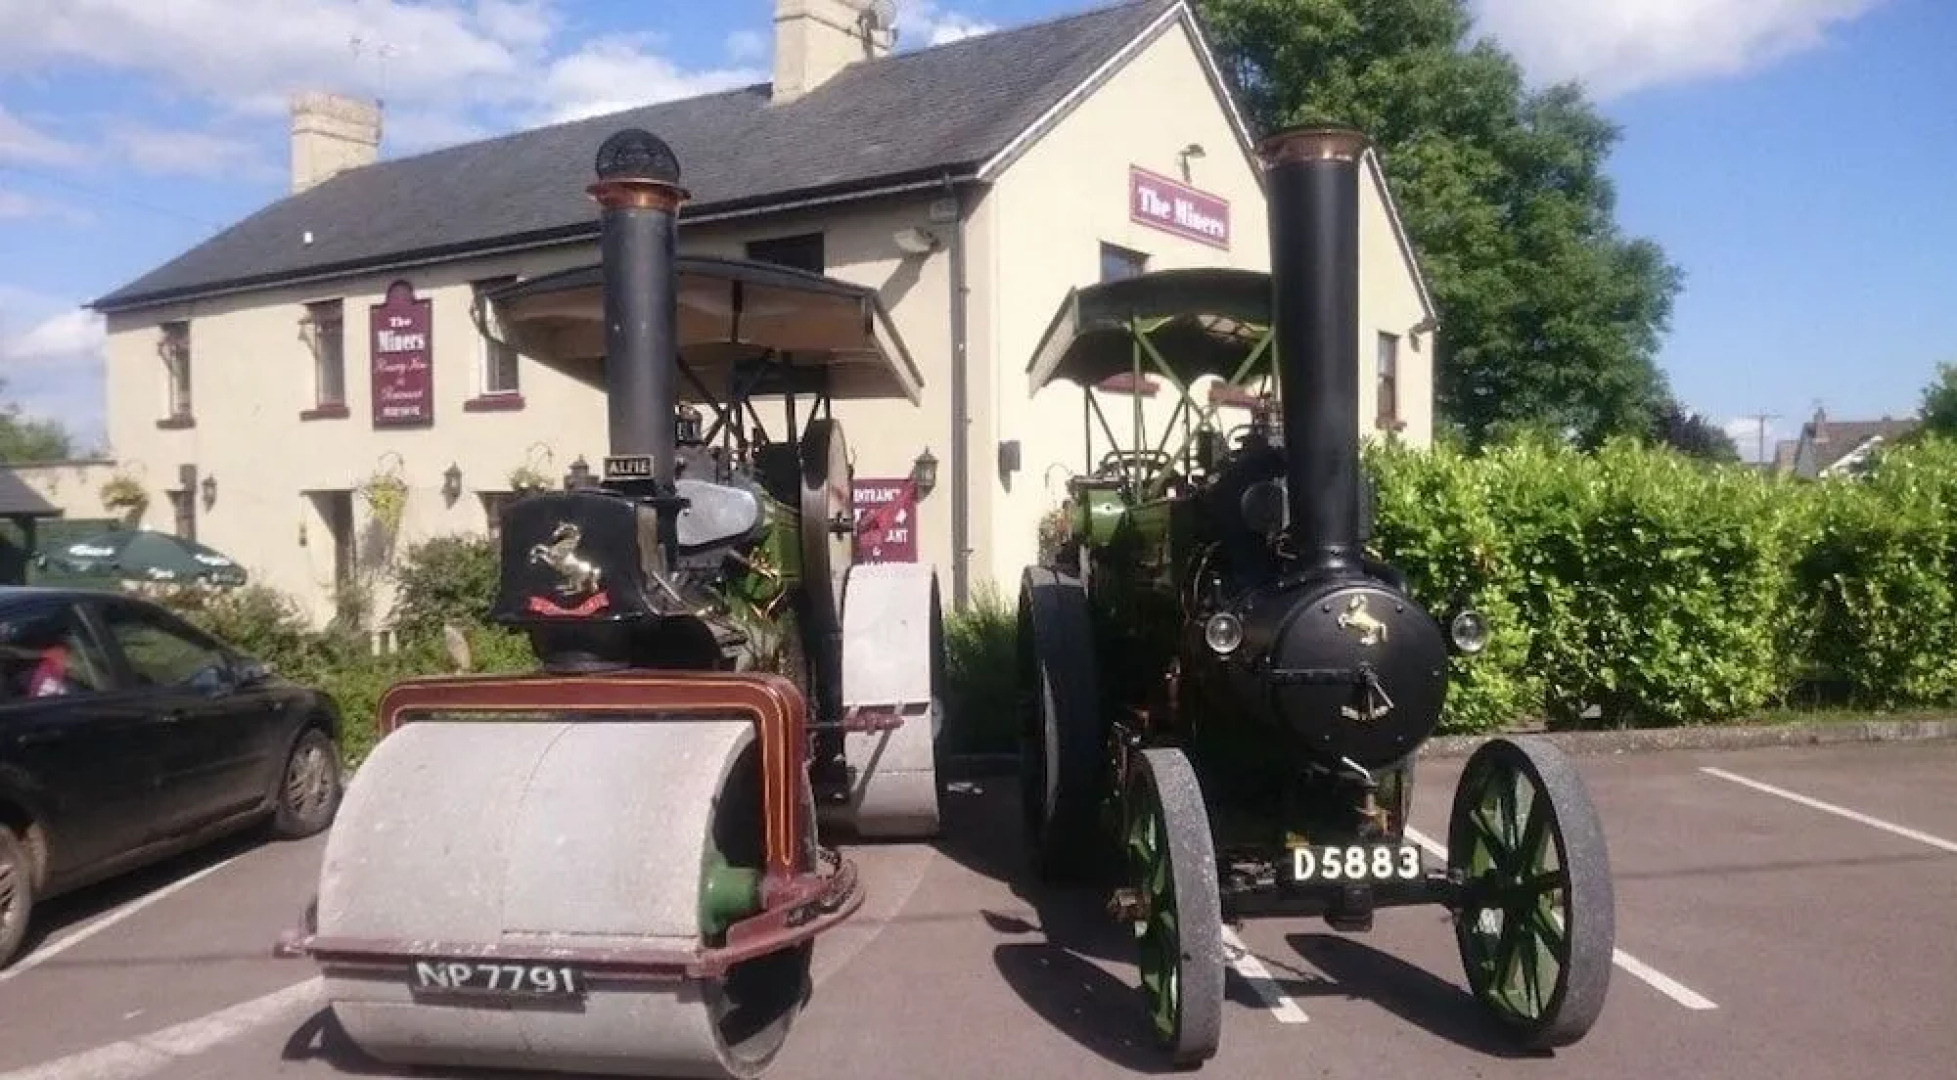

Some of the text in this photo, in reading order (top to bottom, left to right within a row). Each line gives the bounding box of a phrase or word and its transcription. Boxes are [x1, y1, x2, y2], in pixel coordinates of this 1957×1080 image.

[1139, 187, 1224, 238] The Miners
[389, 316, 412, 328] The
[377, 330, 425, 352] Miners
[1294, 846, 1420, 880] D5883
